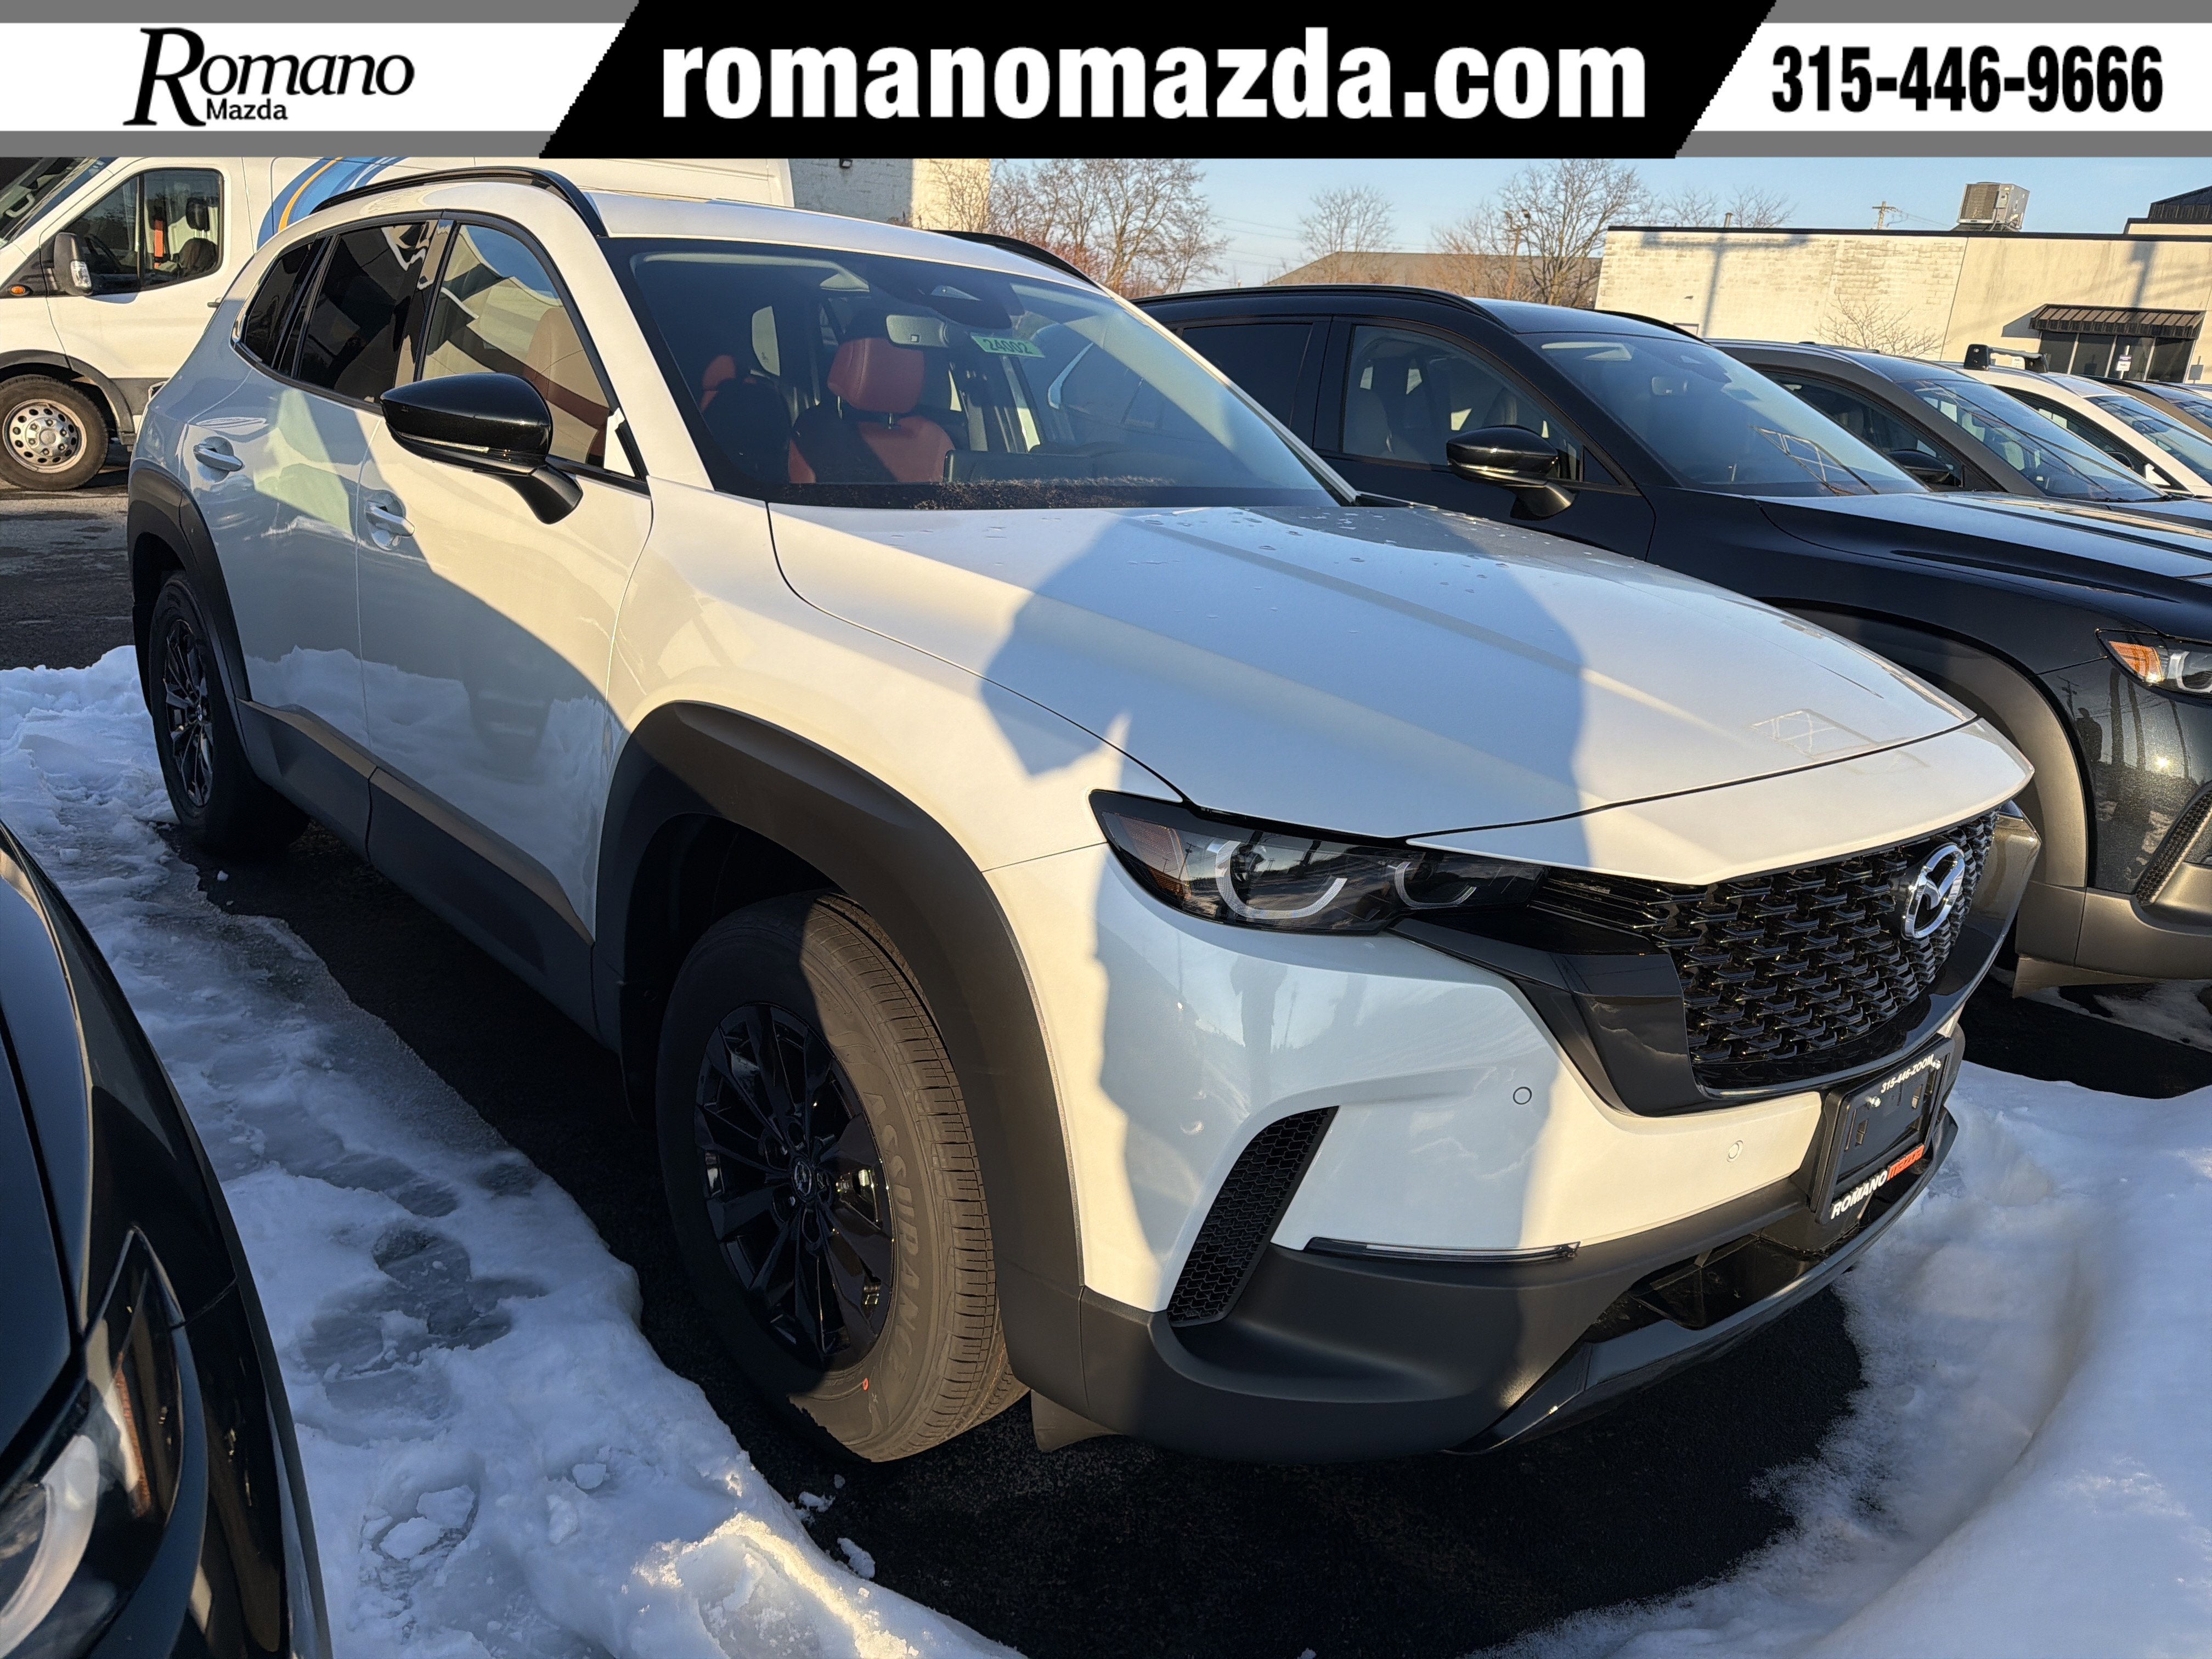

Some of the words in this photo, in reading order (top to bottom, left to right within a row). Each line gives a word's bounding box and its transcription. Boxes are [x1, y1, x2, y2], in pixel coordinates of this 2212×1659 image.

[983, 338, 1032, 354] 24002
[1881, 1053, 1934, 1093] 315-446-ZOOM
[1830, 1170, 1888, 1220] ROMANO
